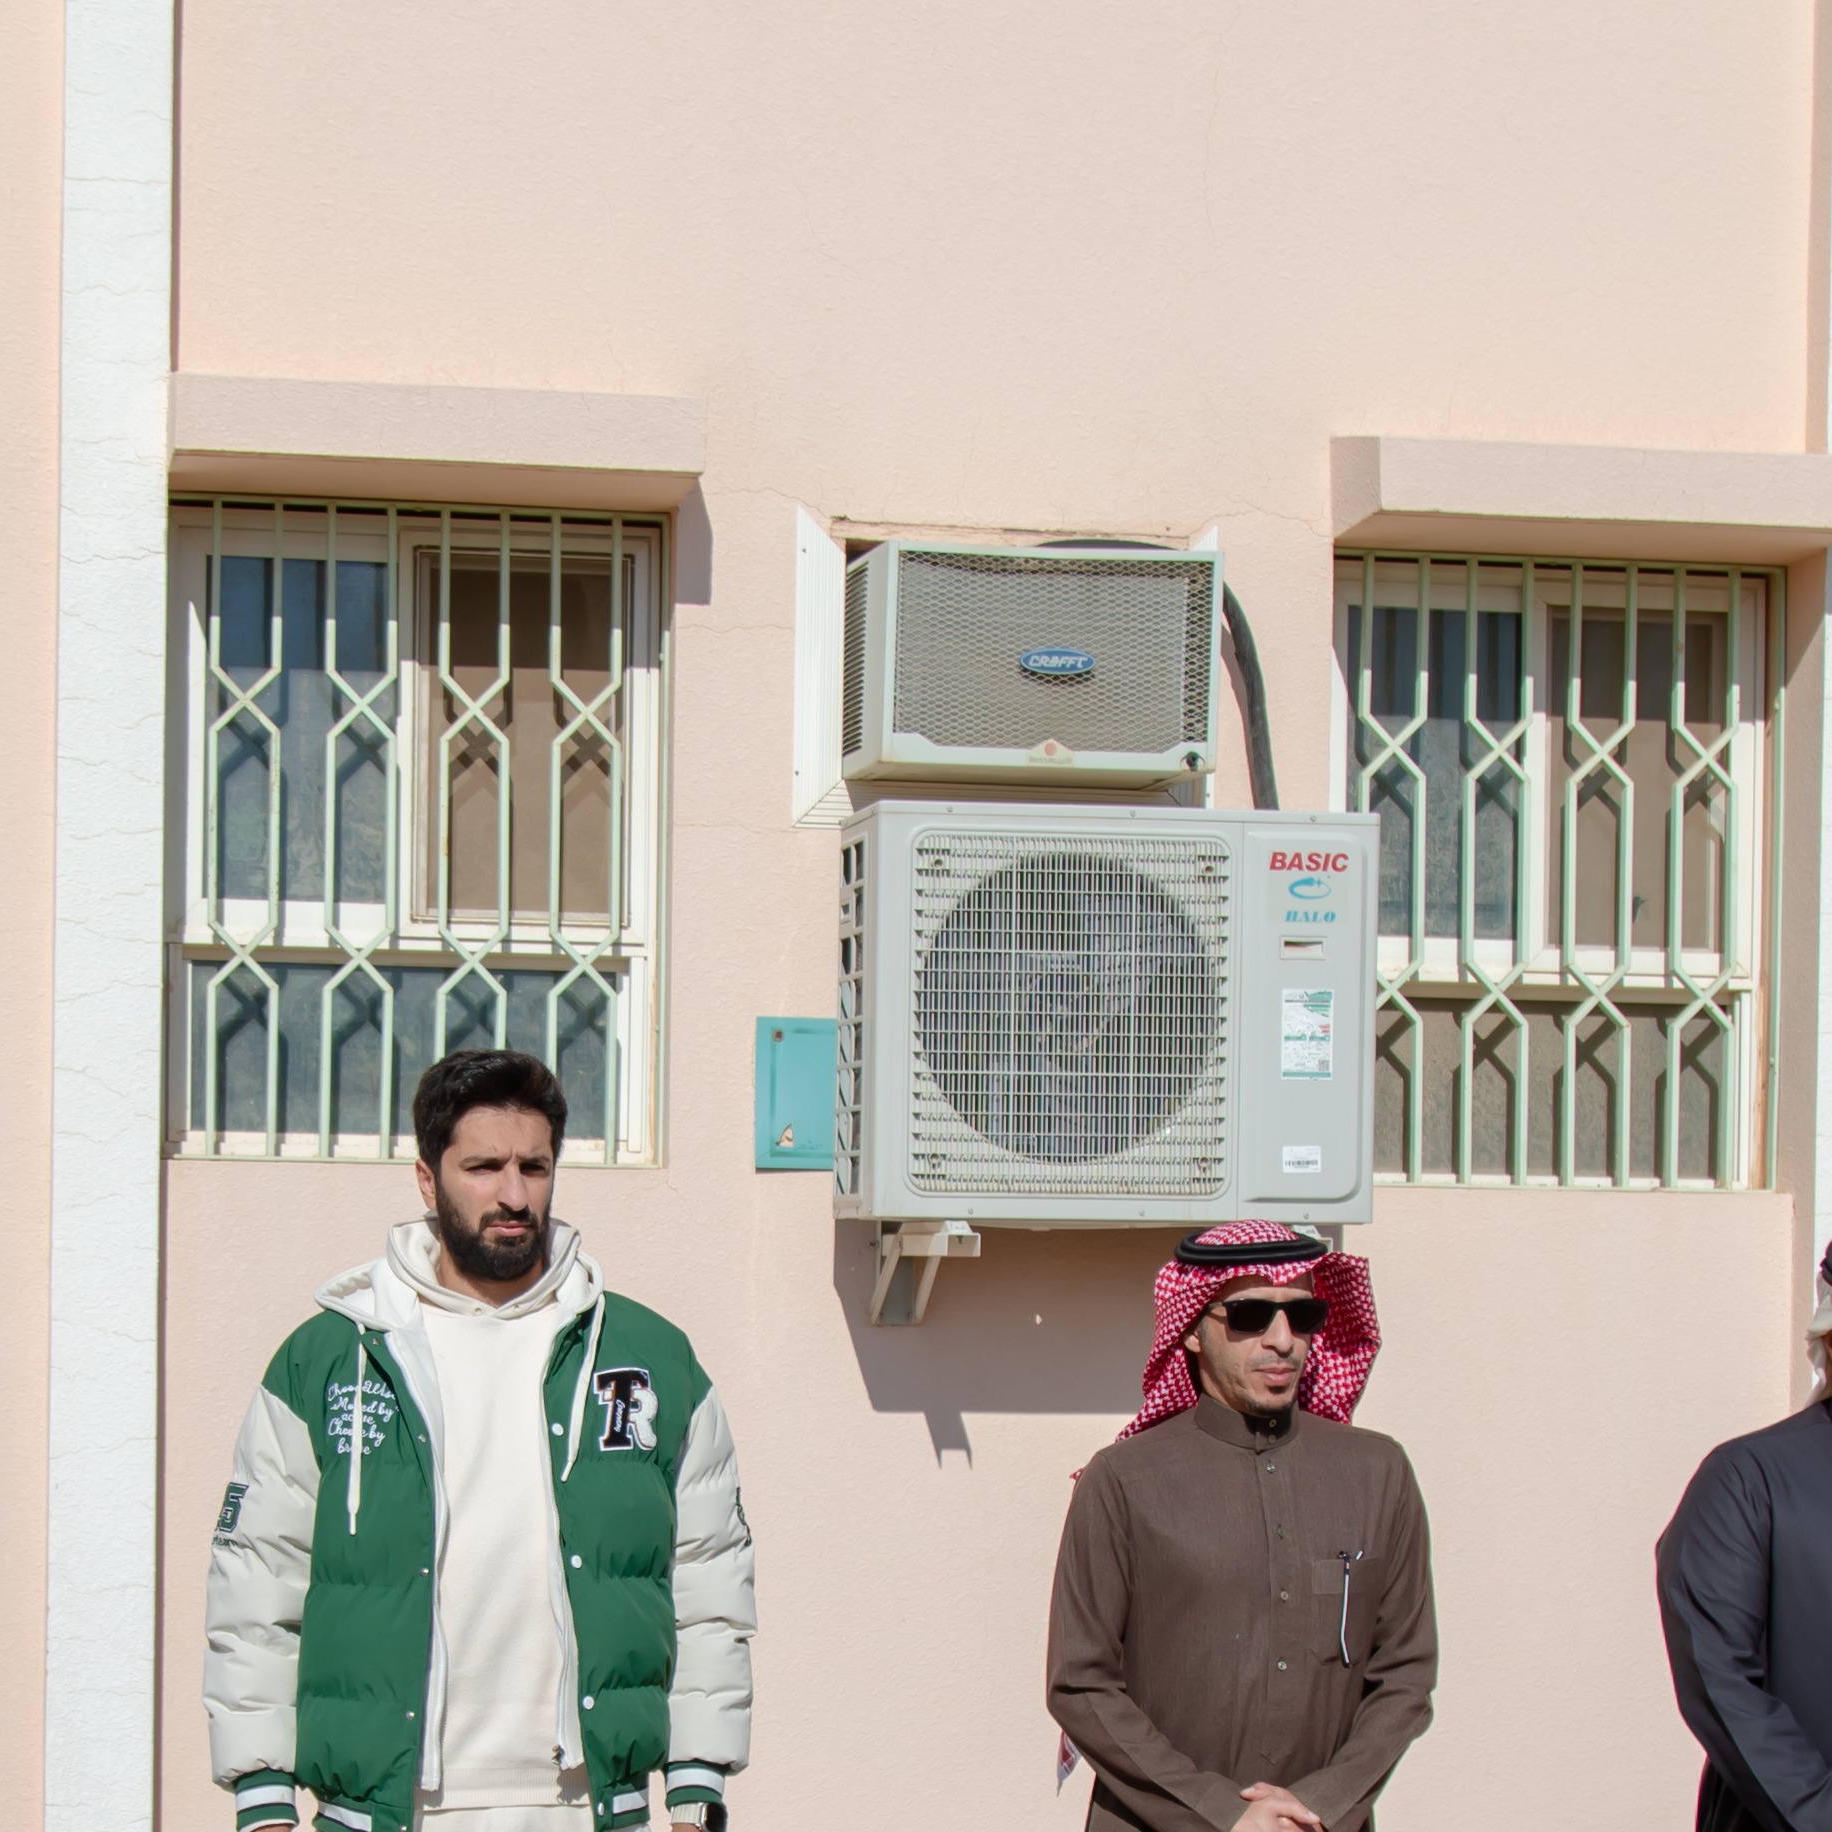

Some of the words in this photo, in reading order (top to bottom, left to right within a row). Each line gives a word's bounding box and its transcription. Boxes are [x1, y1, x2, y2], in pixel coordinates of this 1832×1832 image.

[1269, 851, 1350, 873] BASIC
[1285, 909, 1337, 923] HALO
[327, 1382, 367, 1402] Chooe
[330, 1396, 377, 1413] Moed
[378, 1402, 394, 1423] by
[328, 1417, 368, 1437] Chooe
[368, 1424, 386, 1448] by
[337, 1437, 372, 1455] bre
